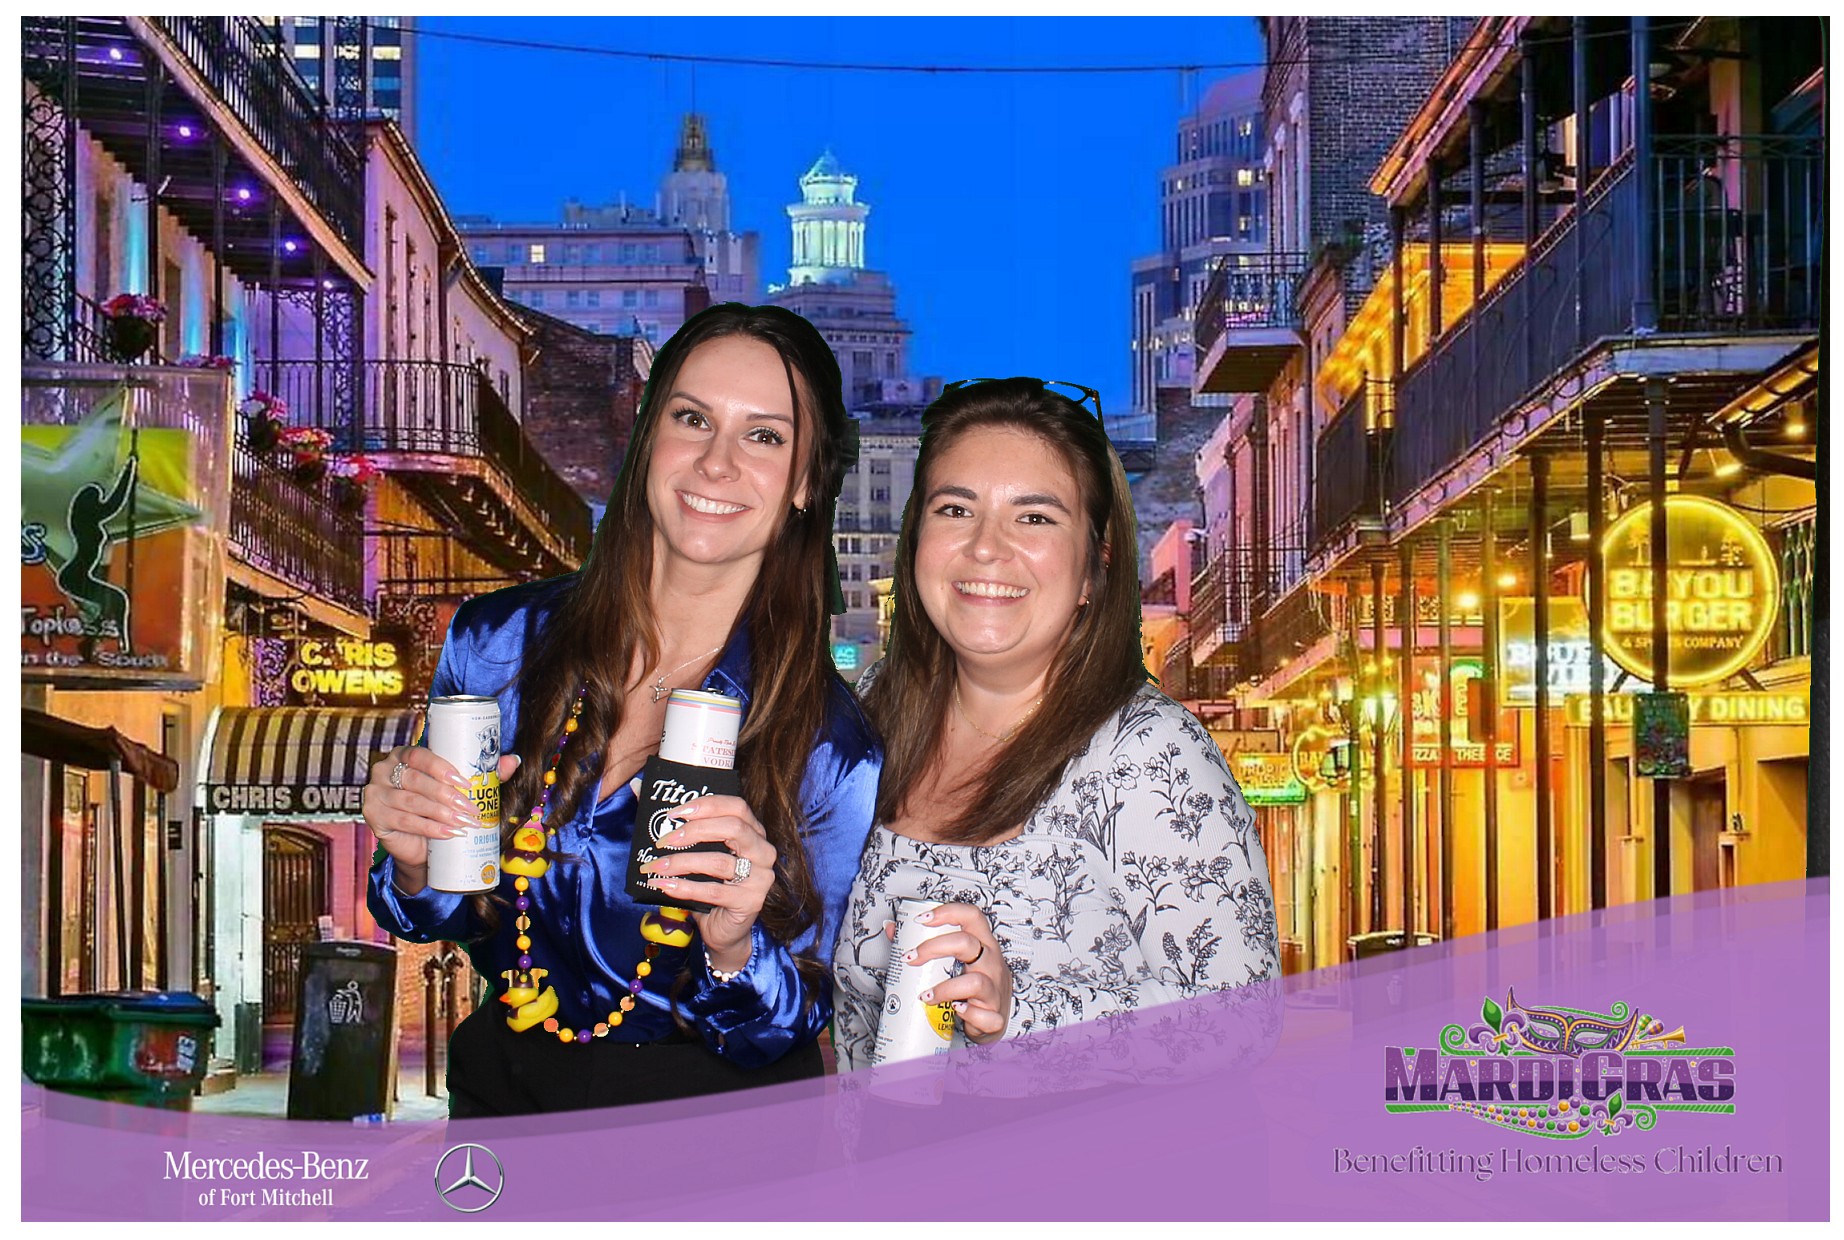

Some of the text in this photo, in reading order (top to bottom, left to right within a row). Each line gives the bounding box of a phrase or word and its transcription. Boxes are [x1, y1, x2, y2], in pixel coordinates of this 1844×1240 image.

[301, 641, 397, 668] CRIS
[1684, 635, 1744, 649] COMPANY
[291, 669, 404, 695] OWENS
[1709, 696, 1806, 721] DINING
[213, 786, 366, 810] CHRIS OWE
